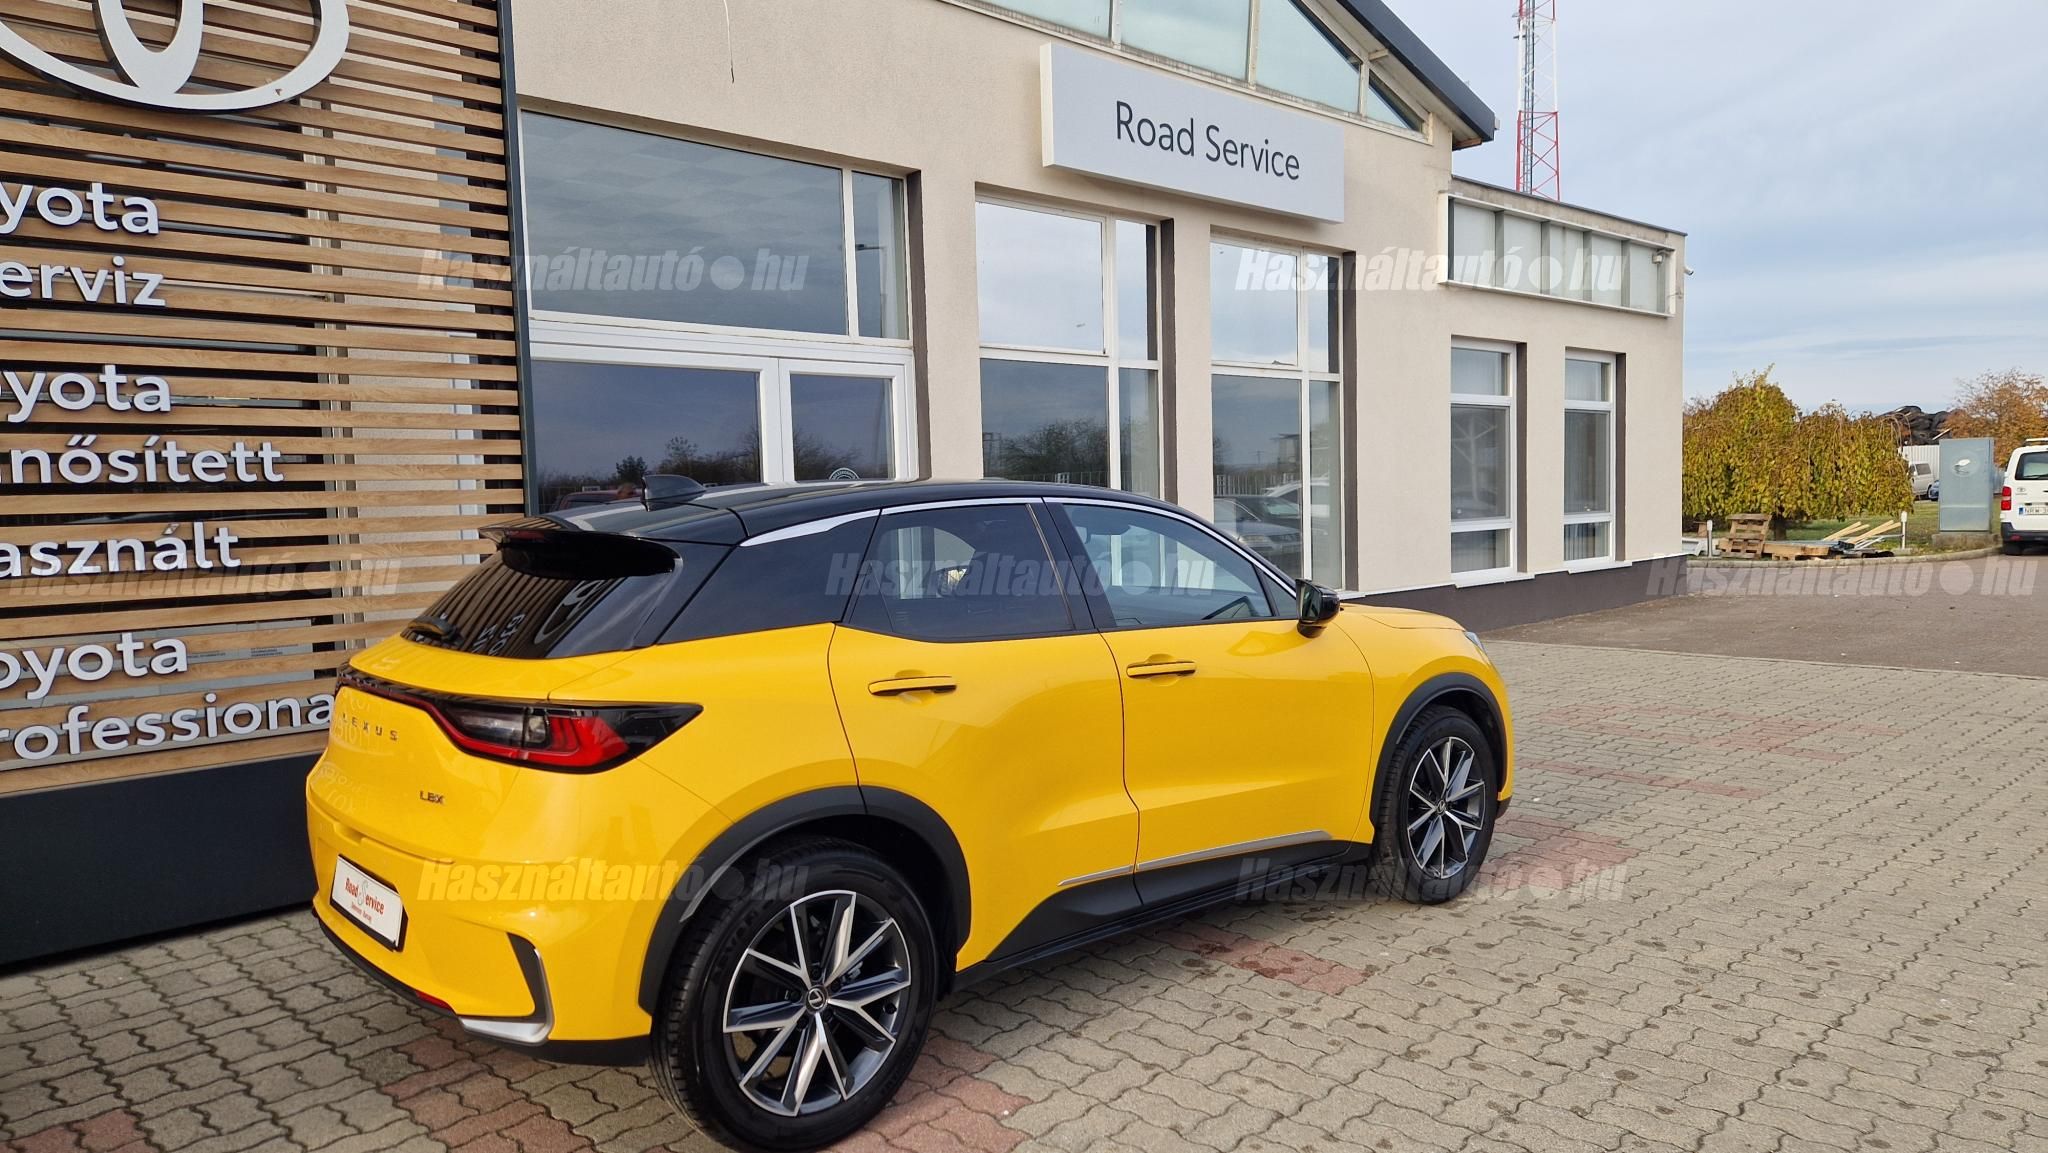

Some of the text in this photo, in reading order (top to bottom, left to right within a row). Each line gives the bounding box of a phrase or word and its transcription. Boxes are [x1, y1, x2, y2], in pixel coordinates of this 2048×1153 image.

[1116, 100, 1300, 181] Road Service
[0, 255, 166, 307] erviz
[0, 364, 172, 423] yota
[0, 434, 285, 484] nősített
[341, 713, 398, 741] LEXUS
[420, 790, 445, 804] LBX
[345, 877, 360, 898] Road
